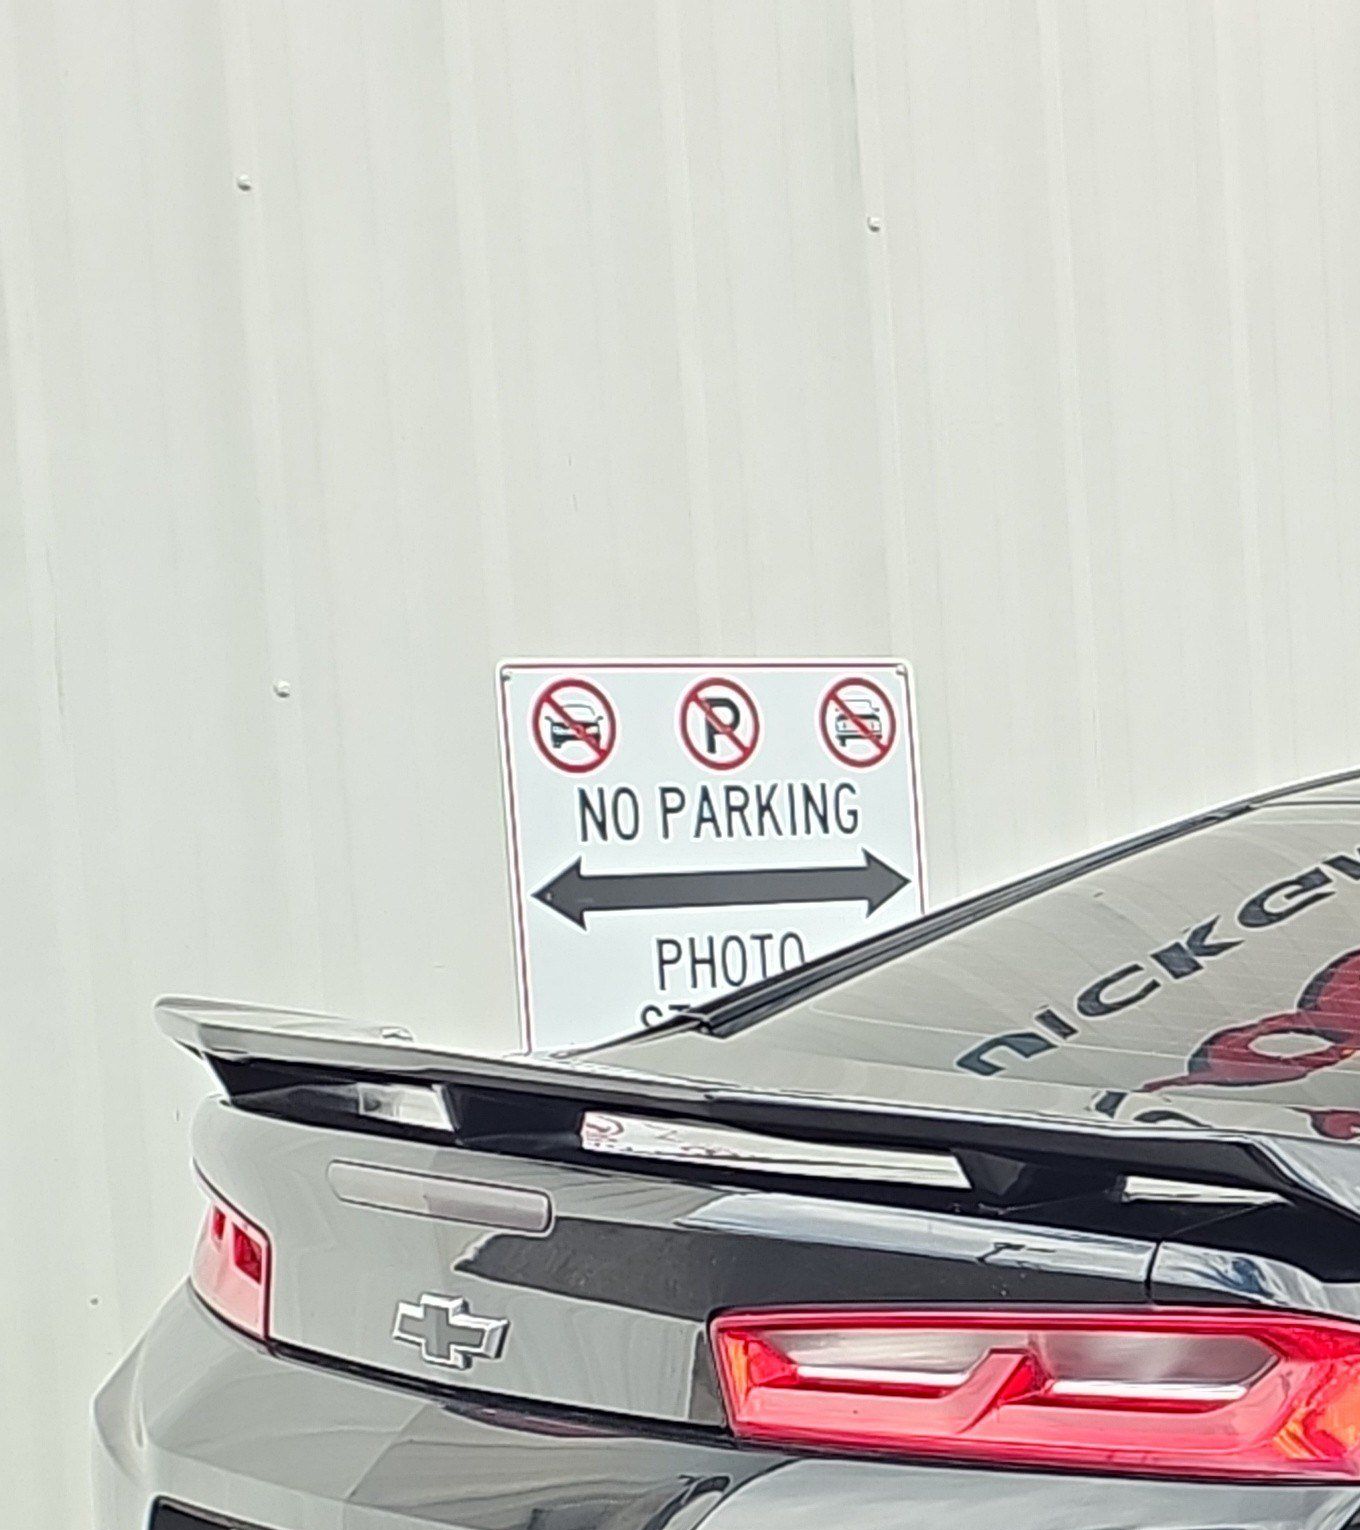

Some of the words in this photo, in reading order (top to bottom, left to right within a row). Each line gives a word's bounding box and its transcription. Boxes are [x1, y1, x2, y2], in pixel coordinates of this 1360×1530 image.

[579, 787, 640, 842] NO
[659, 783, 859, 839] PARKING
[656, 931, 806, 991] PHOTO
